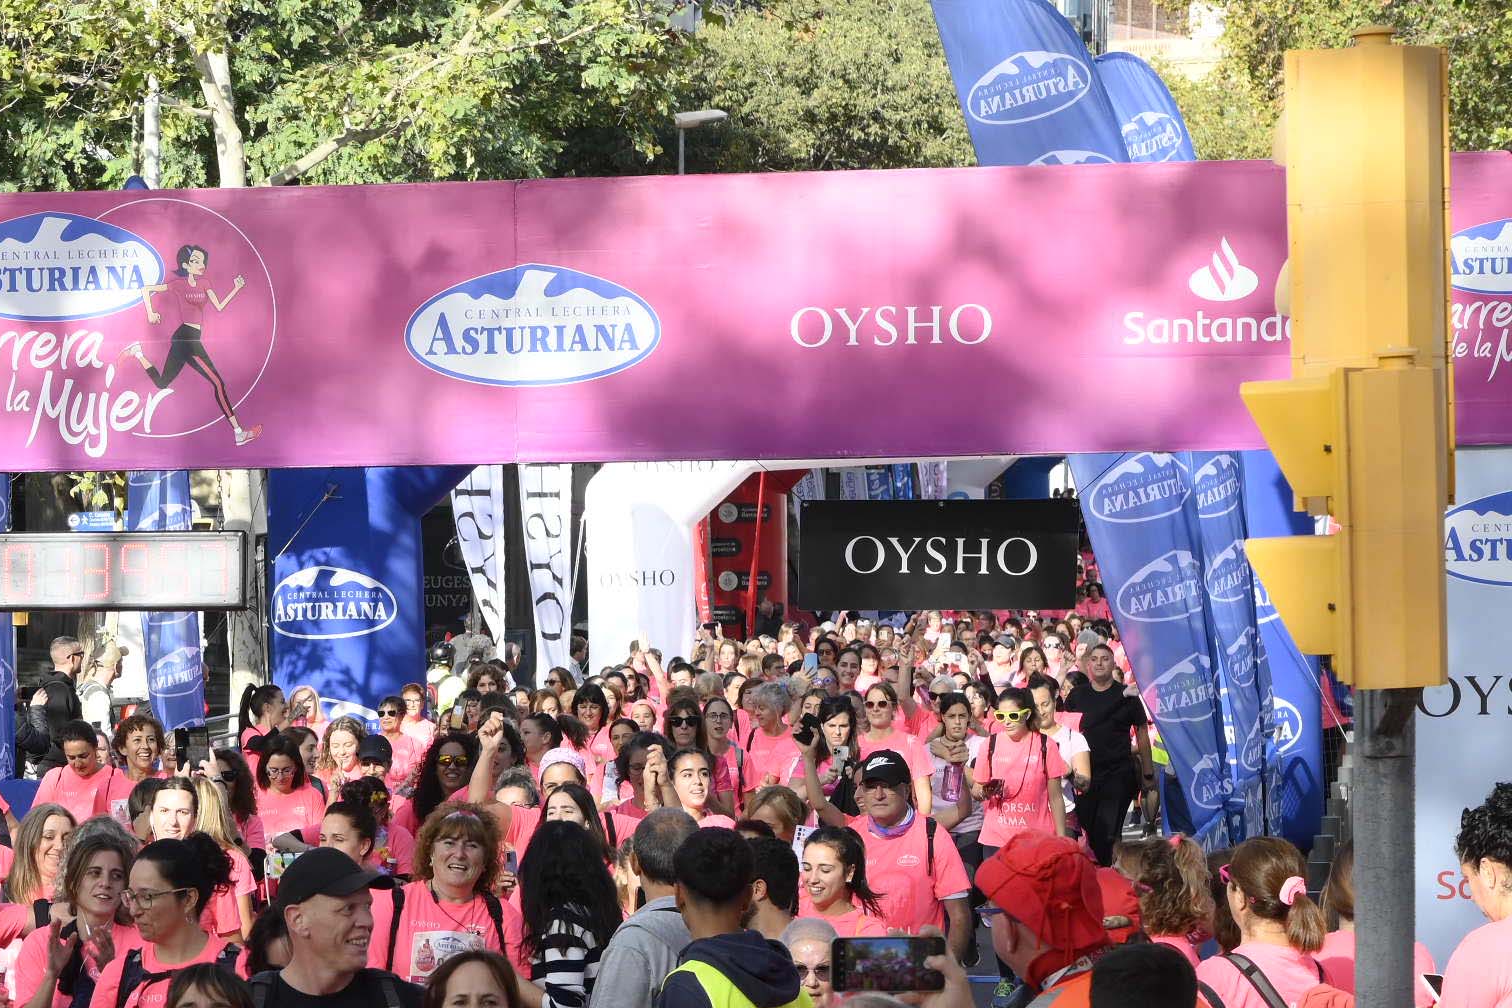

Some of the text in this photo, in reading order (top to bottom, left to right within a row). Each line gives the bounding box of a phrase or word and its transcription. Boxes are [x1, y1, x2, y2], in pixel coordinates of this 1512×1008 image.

[68, 248, 140, 259] LECHERA
[464, 304, 633, 321] CENTRAL LECHERA
[791, 303, 994, 348] OYSHO
[424, 311, 641, 357] ASTURIANA
[5, 369, 31, 413] la
[25, 362, 174, 458] Mujer
[844, 535, 1038, 576] OYSHO
[275, 596, 388, 623] ASTURIANA
[287, 590, 383, 600] CENTRAL LECHERA
